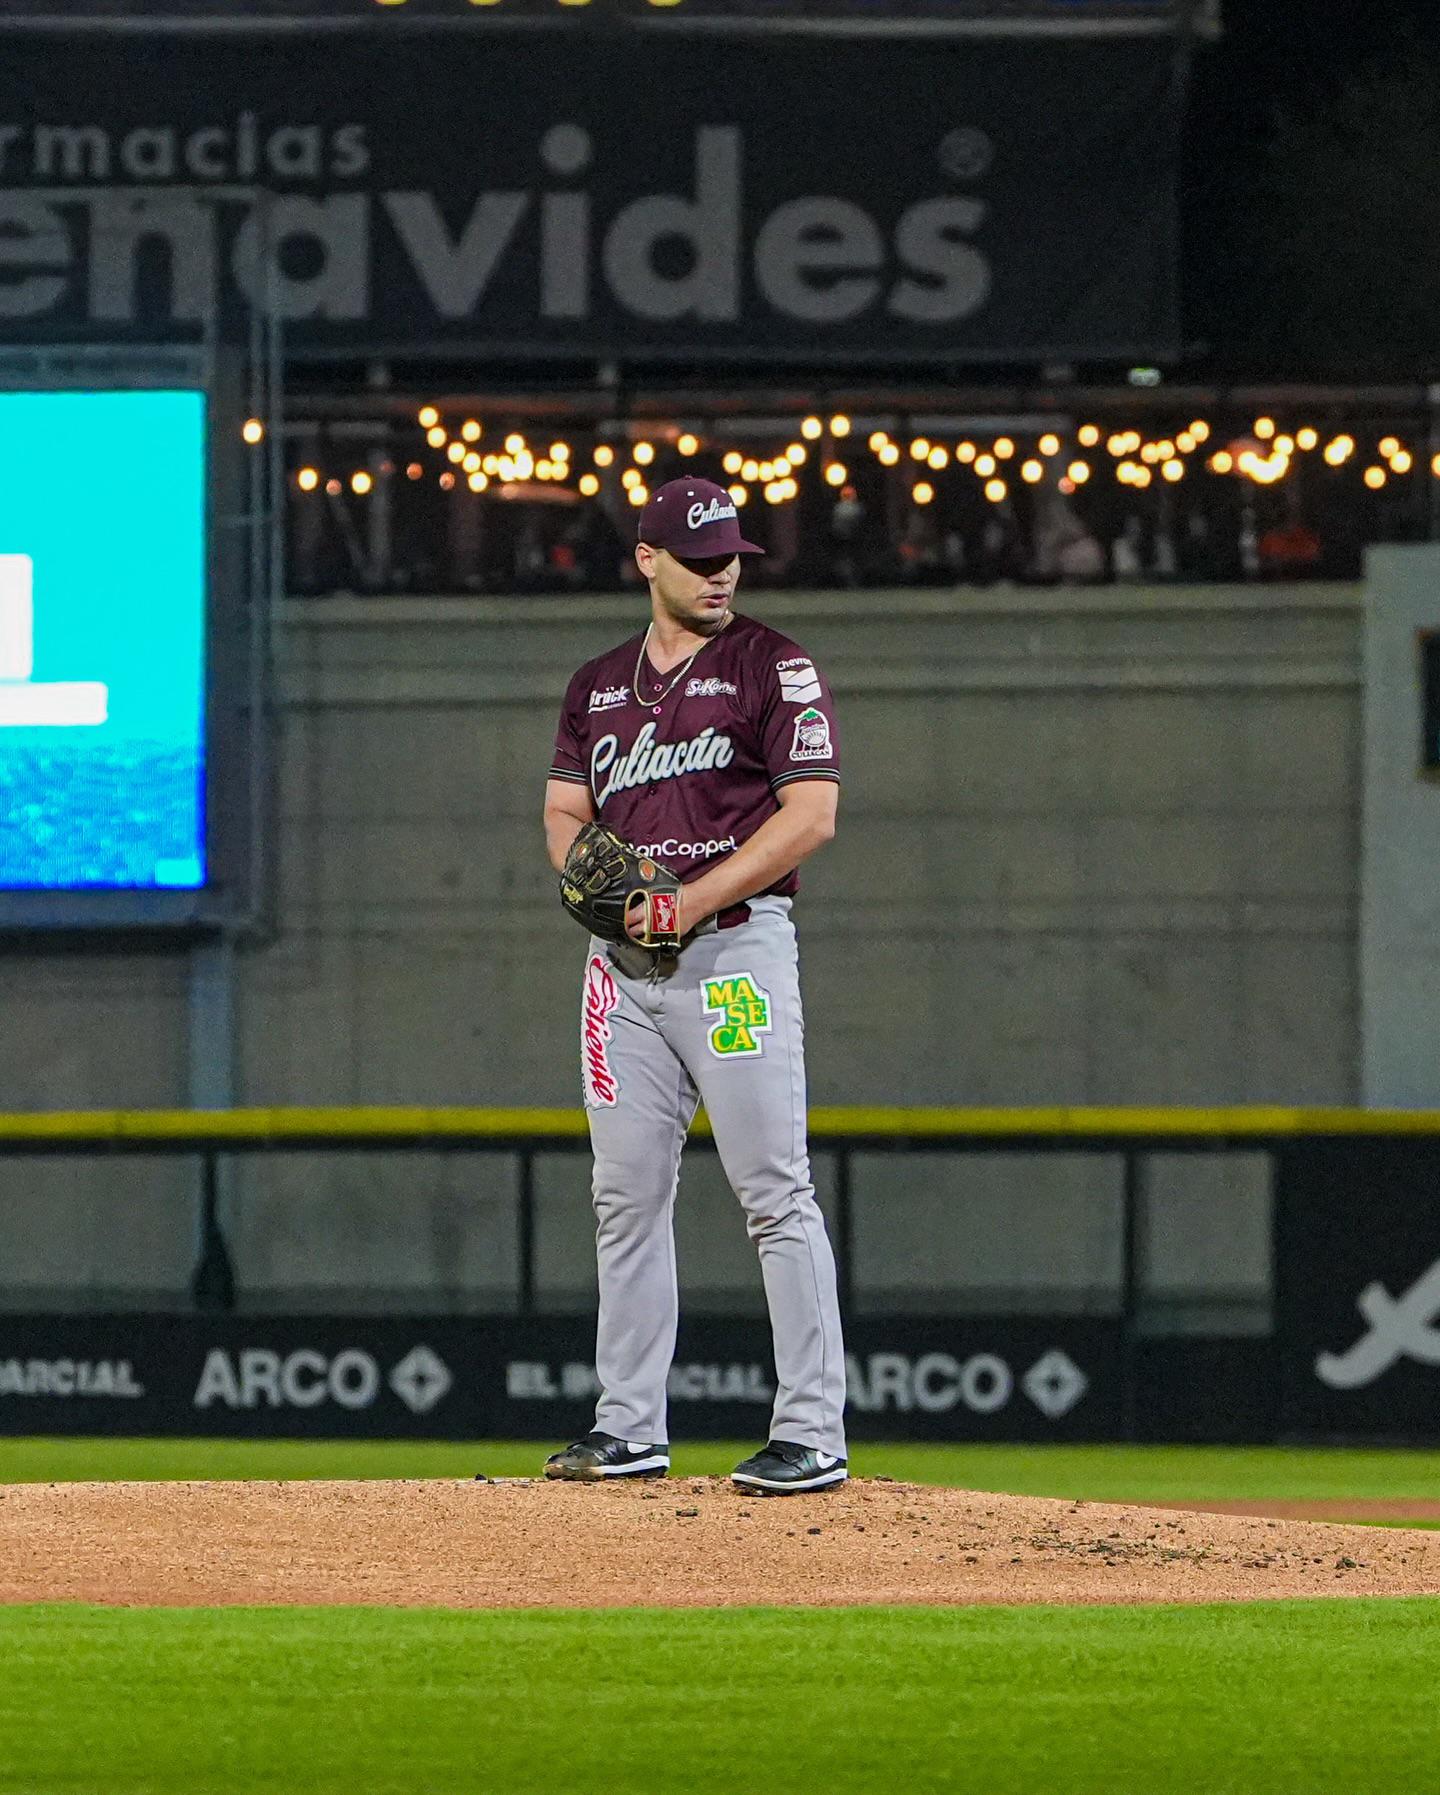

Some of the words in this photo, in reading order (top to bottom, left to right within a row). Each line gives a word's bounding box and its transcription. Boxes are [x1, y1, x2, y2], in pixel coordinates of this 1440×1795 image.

[591, 721, 735, 809] Culiacán
[628, 836, 738, 859] anCoppel
[585, 956, 617, 1103] Caliente
[193, 1349, 379, 1408] ARCO
